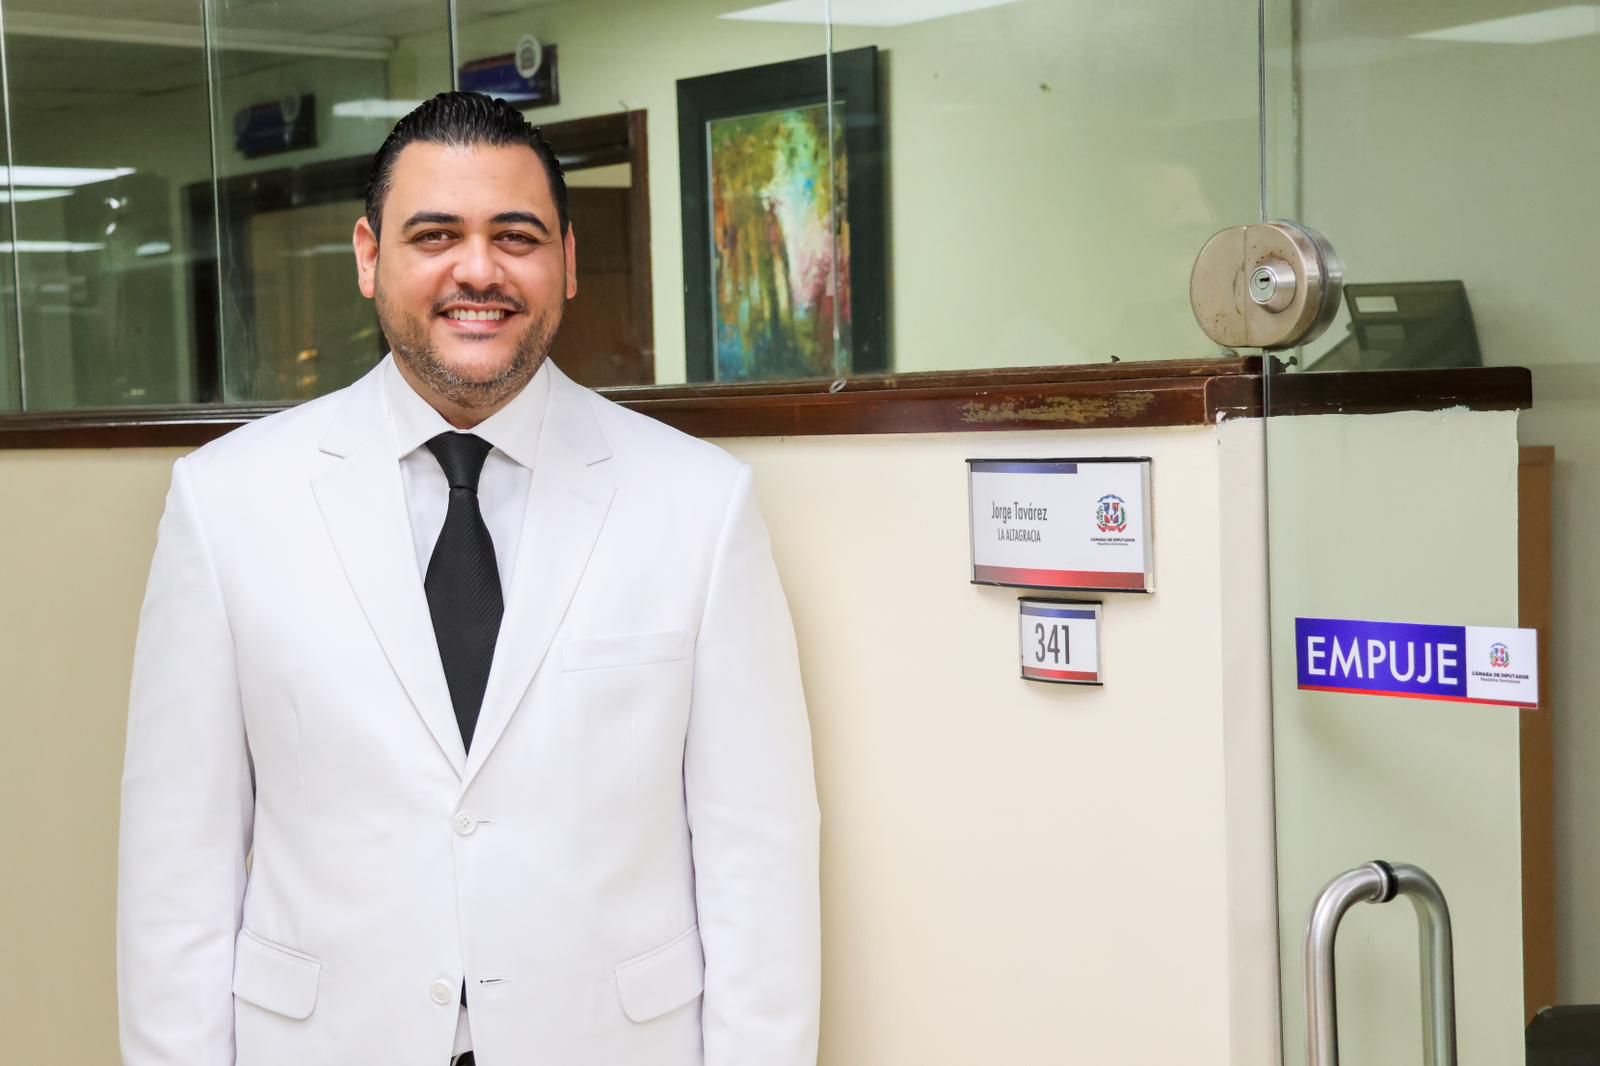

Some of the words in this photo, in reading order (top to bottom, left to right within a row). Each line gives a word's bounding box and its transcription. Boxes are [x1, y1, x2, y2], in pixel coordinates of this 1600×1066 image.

[992, 500, 1011, 524] Jorge
[1014, 501, 1048, 521] Tavárez
[998, 528, 1005, 541] LA
[1006, 528, 1041, 542] ALTAGRACIA
[1035, 622, 1071, 665] 341
[1307, 635, 1458, 685] EMPUJE
